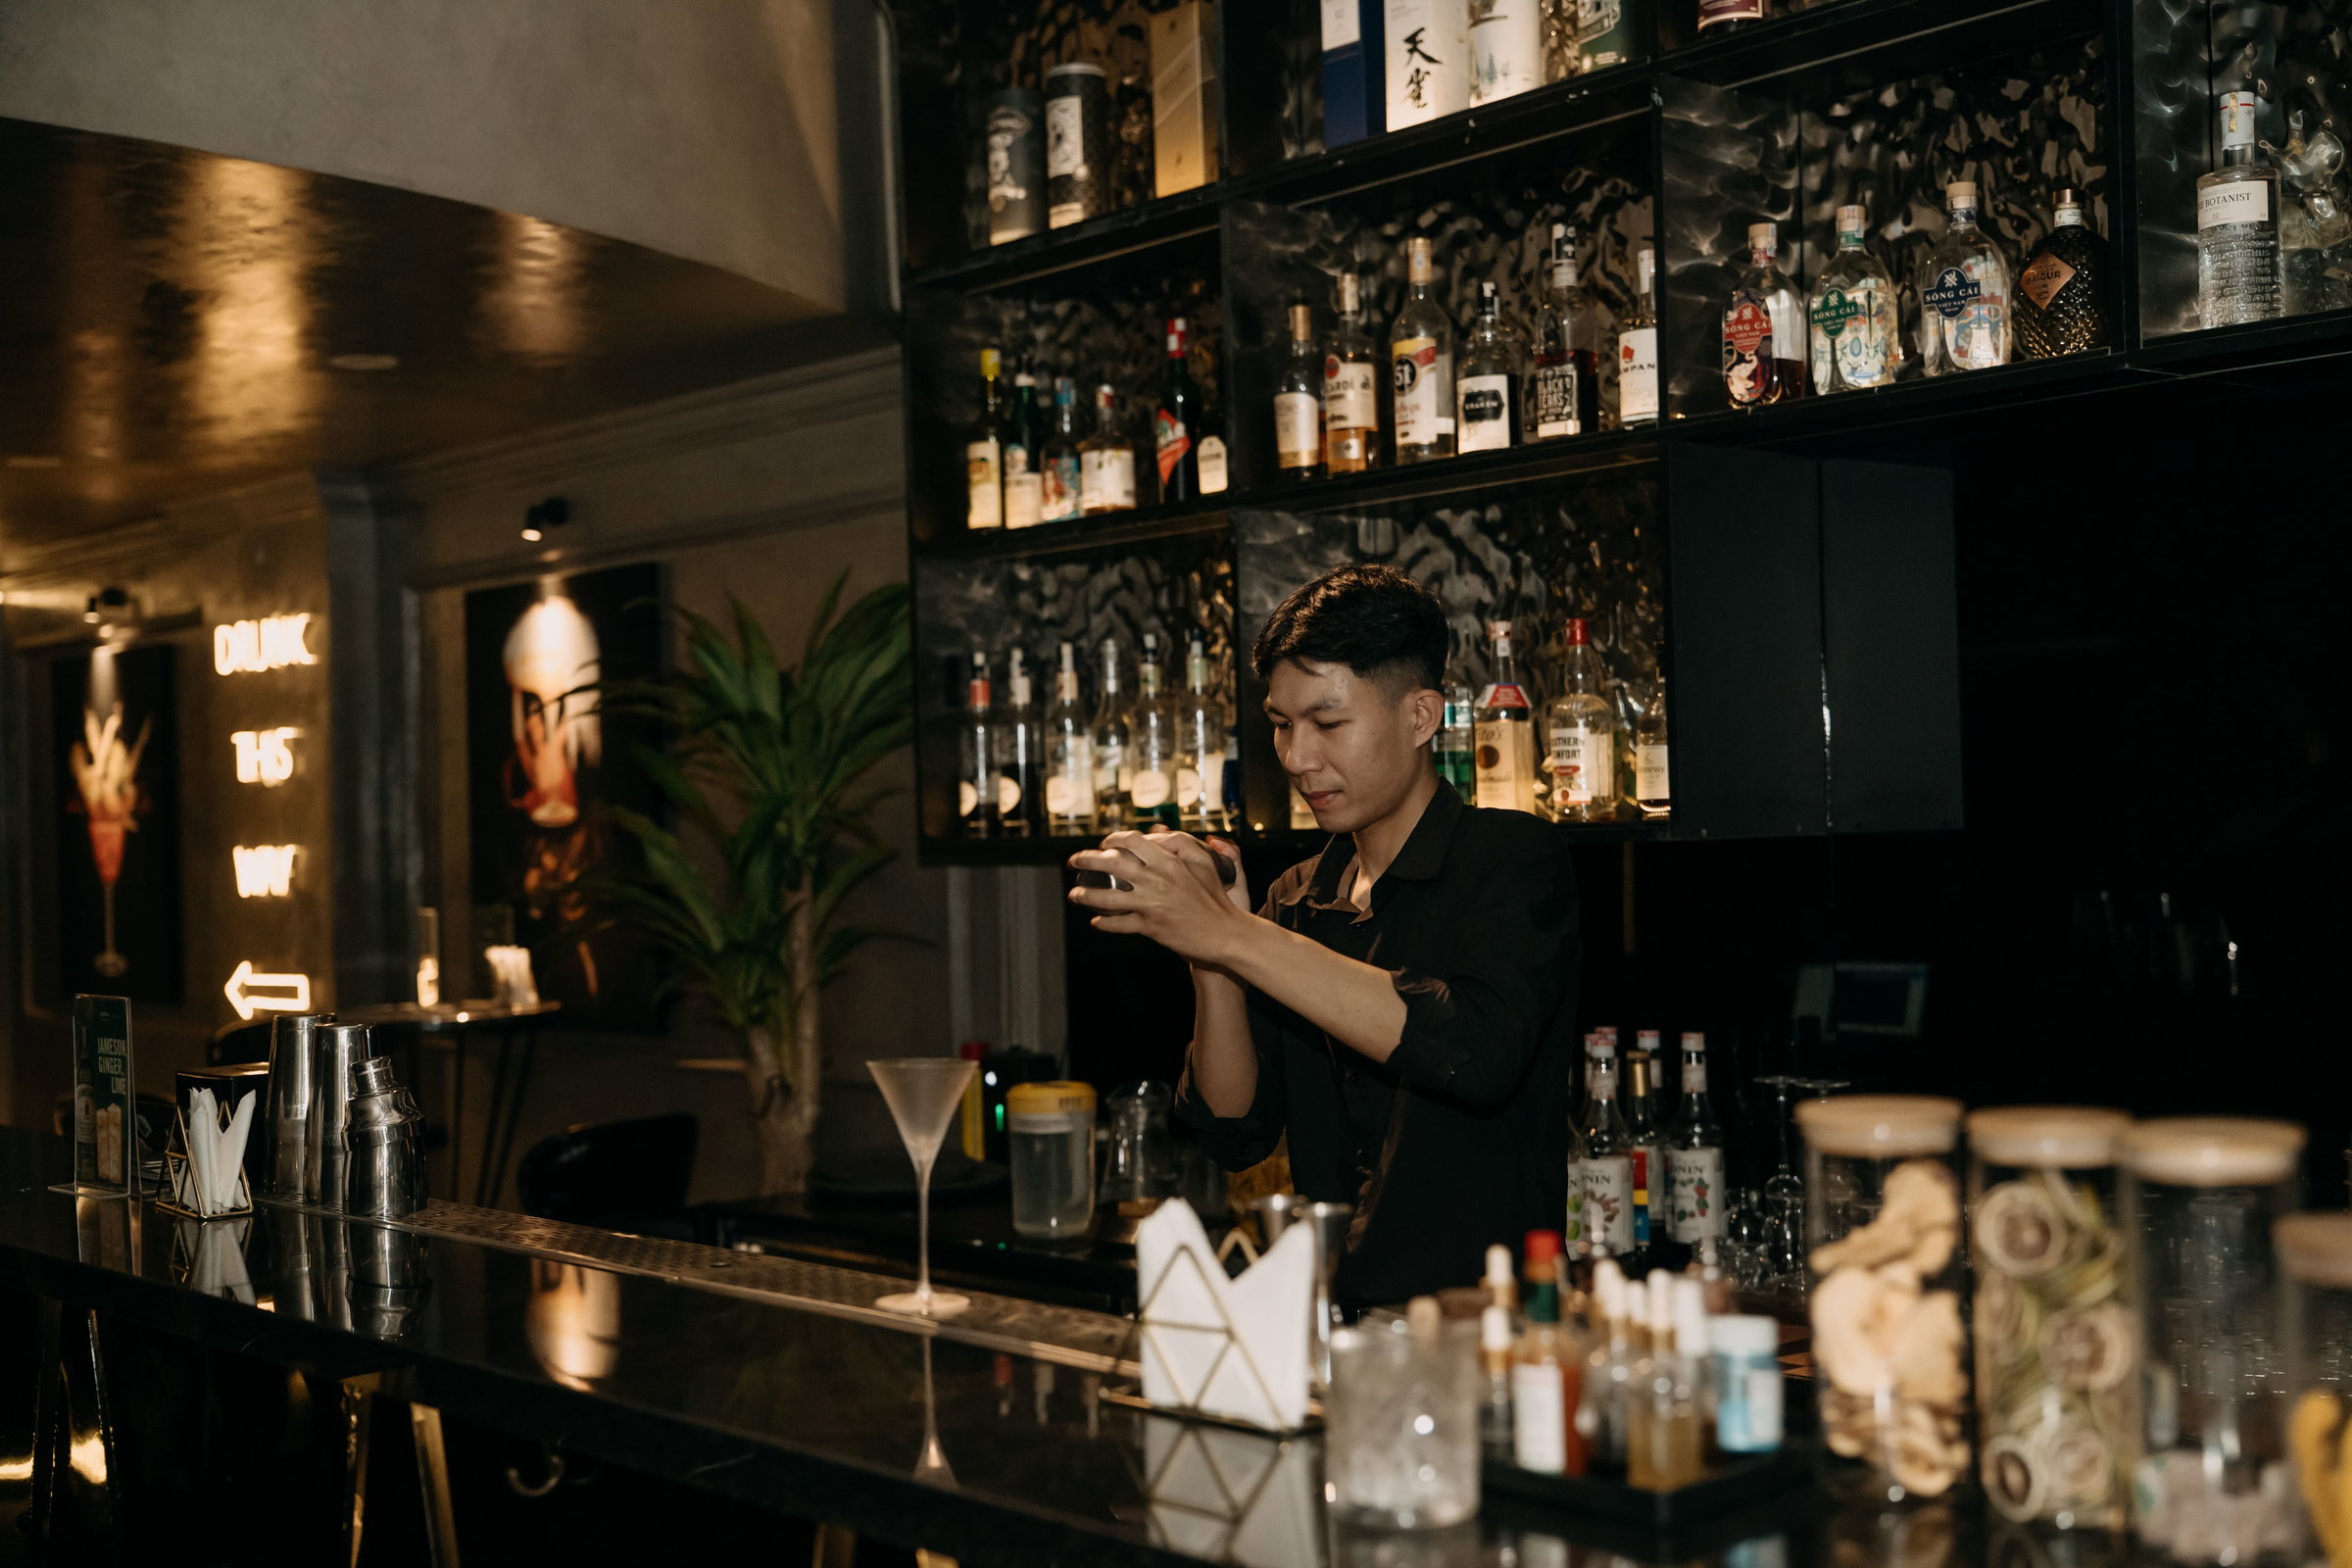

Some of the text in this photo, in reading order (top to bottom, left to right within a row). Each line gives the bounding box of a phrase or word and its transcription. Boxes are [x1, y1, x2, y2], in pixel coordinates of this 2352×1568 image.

[2205, 192, 2251, 207] BOTANIST
[1395, 364, 1412, 387] 51
[111, 1076, 126, 1096] LIME
